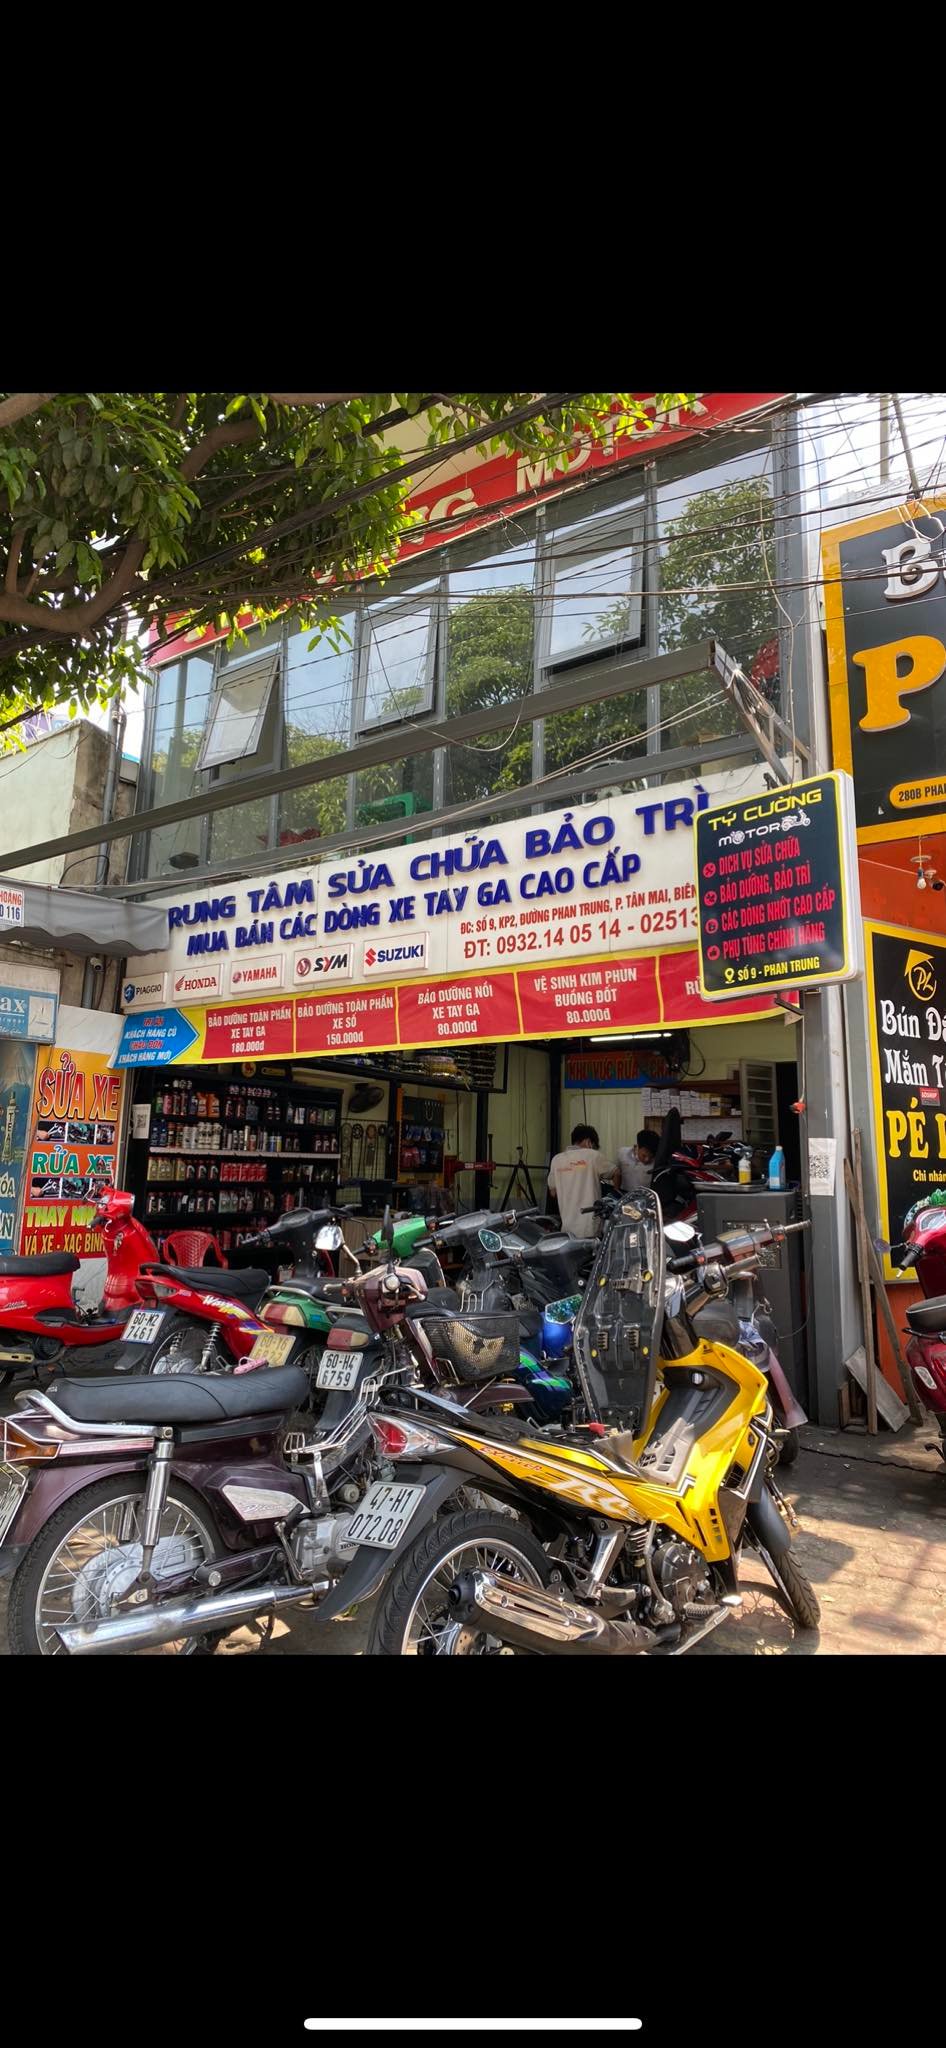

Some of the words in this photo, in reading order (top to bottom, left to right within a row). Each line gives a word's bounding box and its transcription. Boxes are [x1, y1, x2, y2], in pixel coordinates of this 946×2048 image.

[881, 537, 946, 600] B
[743, 788, 822, 822] CƯỜNG
[168, 896, 236, 931] RUNG
[248, 879, 316, 914] TÂM
[328, 859, 396, 899] SỬA
[410, 834, 508, 882] CHỮA
[525, 812, 616, 860] BẢO
[635, 784, 710, 836] TRÌ
[754, 840, 773, 866] SỬA
[720, 877, 737, 903] BẢO
[774, 864, 793, 891] BẢO
[186, 930, 229, 956] MUA
[235, 919, 275, 948] BÁN
[279, 911, 320, 940] CÁC
[324, 902, 382, 934] DÒNG
[389, 895, 416, 923] XE
[424, 886, 470, 917] TAY
[477, 878, 513, 908] GA
[519, 866, 576, 901] CAO
[583, 846, 642, 889] CẤP
[460, 921, 475, 935] ĐC:
[476, 914, 488, 933] SỐ
[499, 914, 518, 930] KP2,
[520, 908, 551, 926] ĐƯỜNG
[551, 904, 578, 922] PHAN
[579, 899, 614, 917] TRUNG,
[615, 896, 624, 911] P.
[626, 890, 646, 909] TÂN
[649, 887, 672, 905] MAI,
[721, 907, 739, 932] CÁC
[740, 902, 765, 928] DÒNG
[794, 894, 813, 916] CAO
[815, 882, 836, 912] CẤP
[464, 938, 491, 959] ĐT:
[496, 927, 565, 956] 0932.14
[569, 923, 593, 944] 05
[598, 917, 623, 941] 14
[722, 938, 740, 961] PHỤ
[742, 932, 766, 956] TÙNG
[767, 925, 796, 952] CHÍNH
[312, 953, 349, 973] SYM
[376, 944, 425, 963] SUZUKI
[242, 966, 278, 981] YAMAHA
[533, 975, 548, 994] VỆ
[550, 974, 577, 990] SINH
[580, 971, 602, 987] KIM
[605, 967, 638, 984] PHUN
[737, 964, 749, 981] SỐ
[750, 967, 757, 979] 9
[763, 961, 789, 977] PHAN
[790, 956, 820, 972] TRUNG
[135, 982, 163, 997] PIAGGIO
[183, 975, 218, 991] HONDA
[596, 984, 618, 1004] ĐỐT
[297, 1002, 314, 1018] BẢO
[345, 998, 367, 1012] TOÀN
[418, 988, 436, 1005] BẢO
[207, 1013, 222, 1028] BẢO
[249, 1009, 269, 1023] TOÀN
[332, 1018, 343, 1030] XE
[345, 1012, 357, 1028] SỐ
[432, 1006, 445, 1020] XE
[447, 1004, 463, 1018] TAY
[466, 1002, 480, 1016] GA
[566, 1007, 611, 1024] 80.000đ
[880, 999, 921, 1039] Bún
[230, 1028, 241, 1040] XE
[242, 1026, 254, 1038] TAY
[255, 1025, 266, 1037] GA
[326, 1030, 364, 1046] 150.000đ
[437, 1020, 478, 1036] 80.000đ
[884, 1047, 930, 1087] Mắm
[932, 1054, 946, 1089] T
[36, 1051, 86, 1120] SỬA
[90, 1072, 121, 1121] XE
[886, 1096, 929, 1159] PÉ
[31, 1144, 81, 1176] RỬA
[87, 1154, 115, 1175] XE
[913, 1169, 927, 1182] Chi
[25, 1205, 69, 1228] THAY
[24, 1229, 38, 1256] VÁ
[40, 1234, 55, 1255] XE
[321, 1370, 351, 1387] 6759
[369, 1485, 415, 1514] 47-H1
[347, 1513, 404, 1544] 072.08
